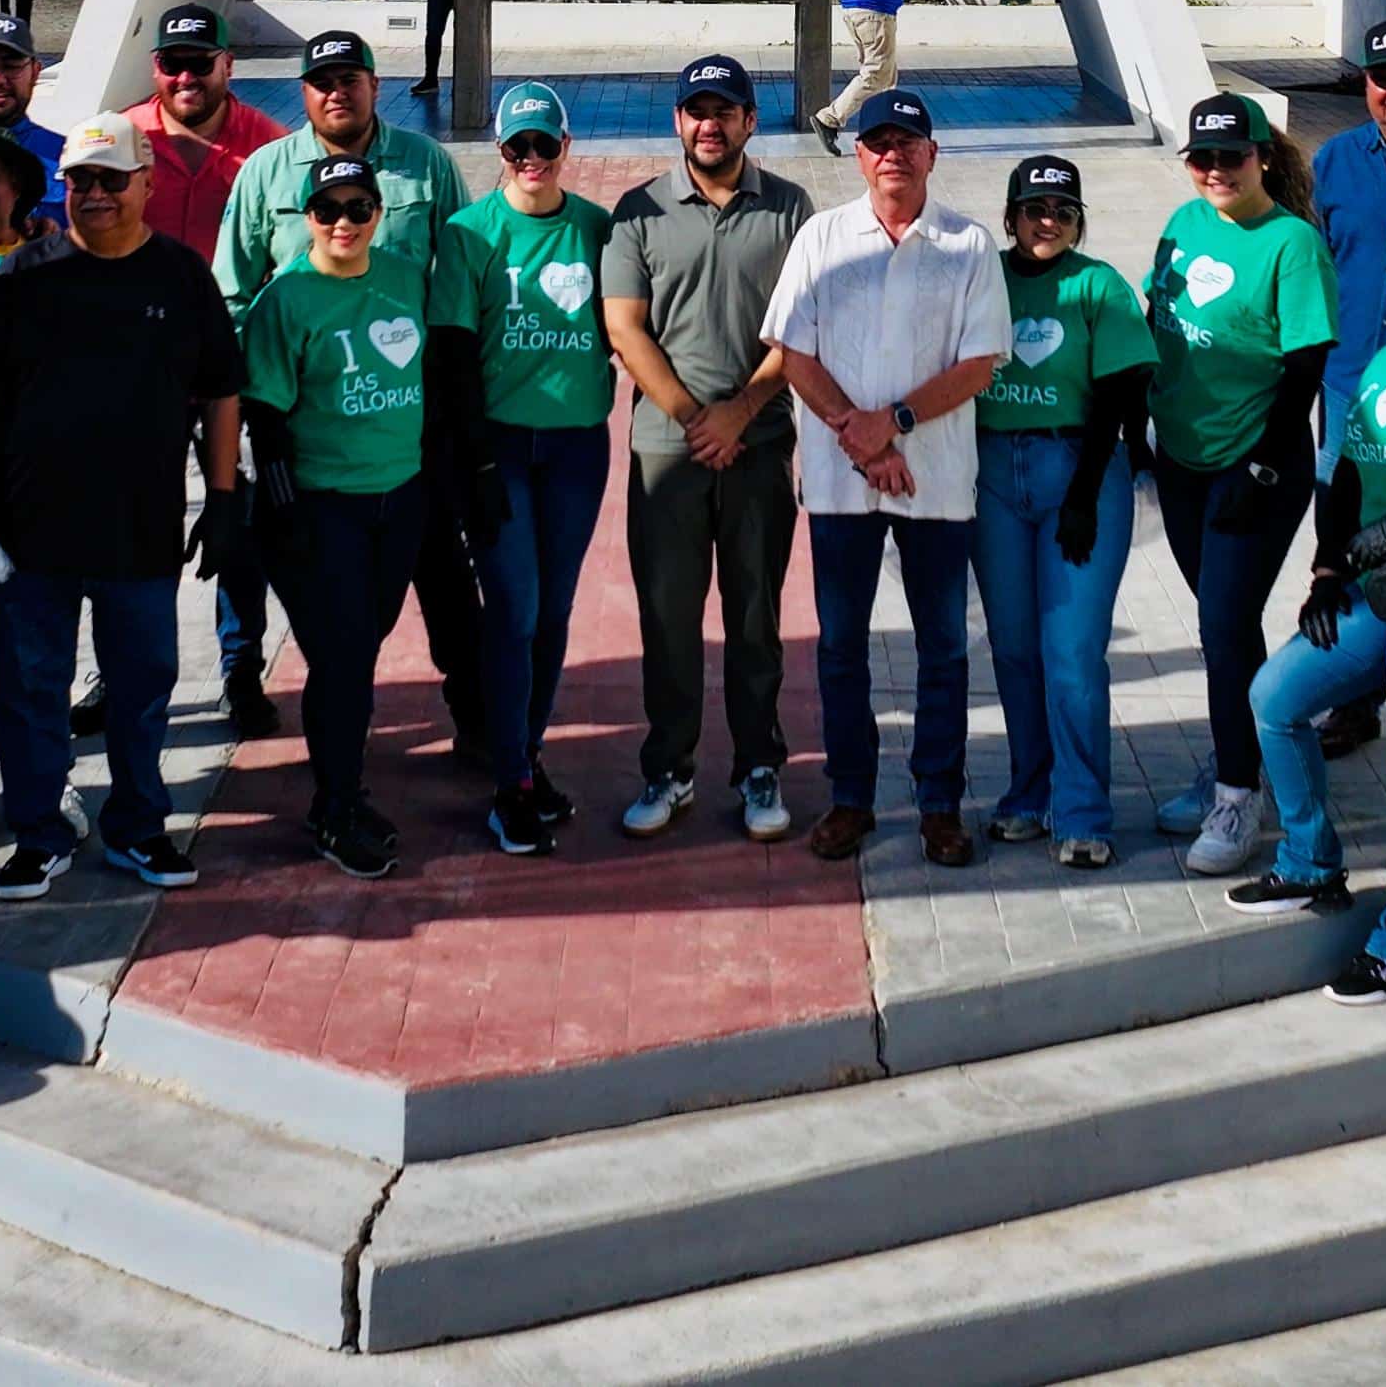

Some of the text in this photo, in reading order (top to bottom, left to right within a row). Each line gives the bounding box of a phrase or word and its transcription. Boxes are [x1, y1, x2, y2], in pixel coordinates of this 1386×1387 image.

[505, 266, 524, 310] I
[505, 312, 541, 331] LAS
[334, 328, 360, 374] I
[502, 330, 594, 352] GLORIAS
[342, 373, 379, 395] LAS
[342, 383, 422, 416] GLORIAS
